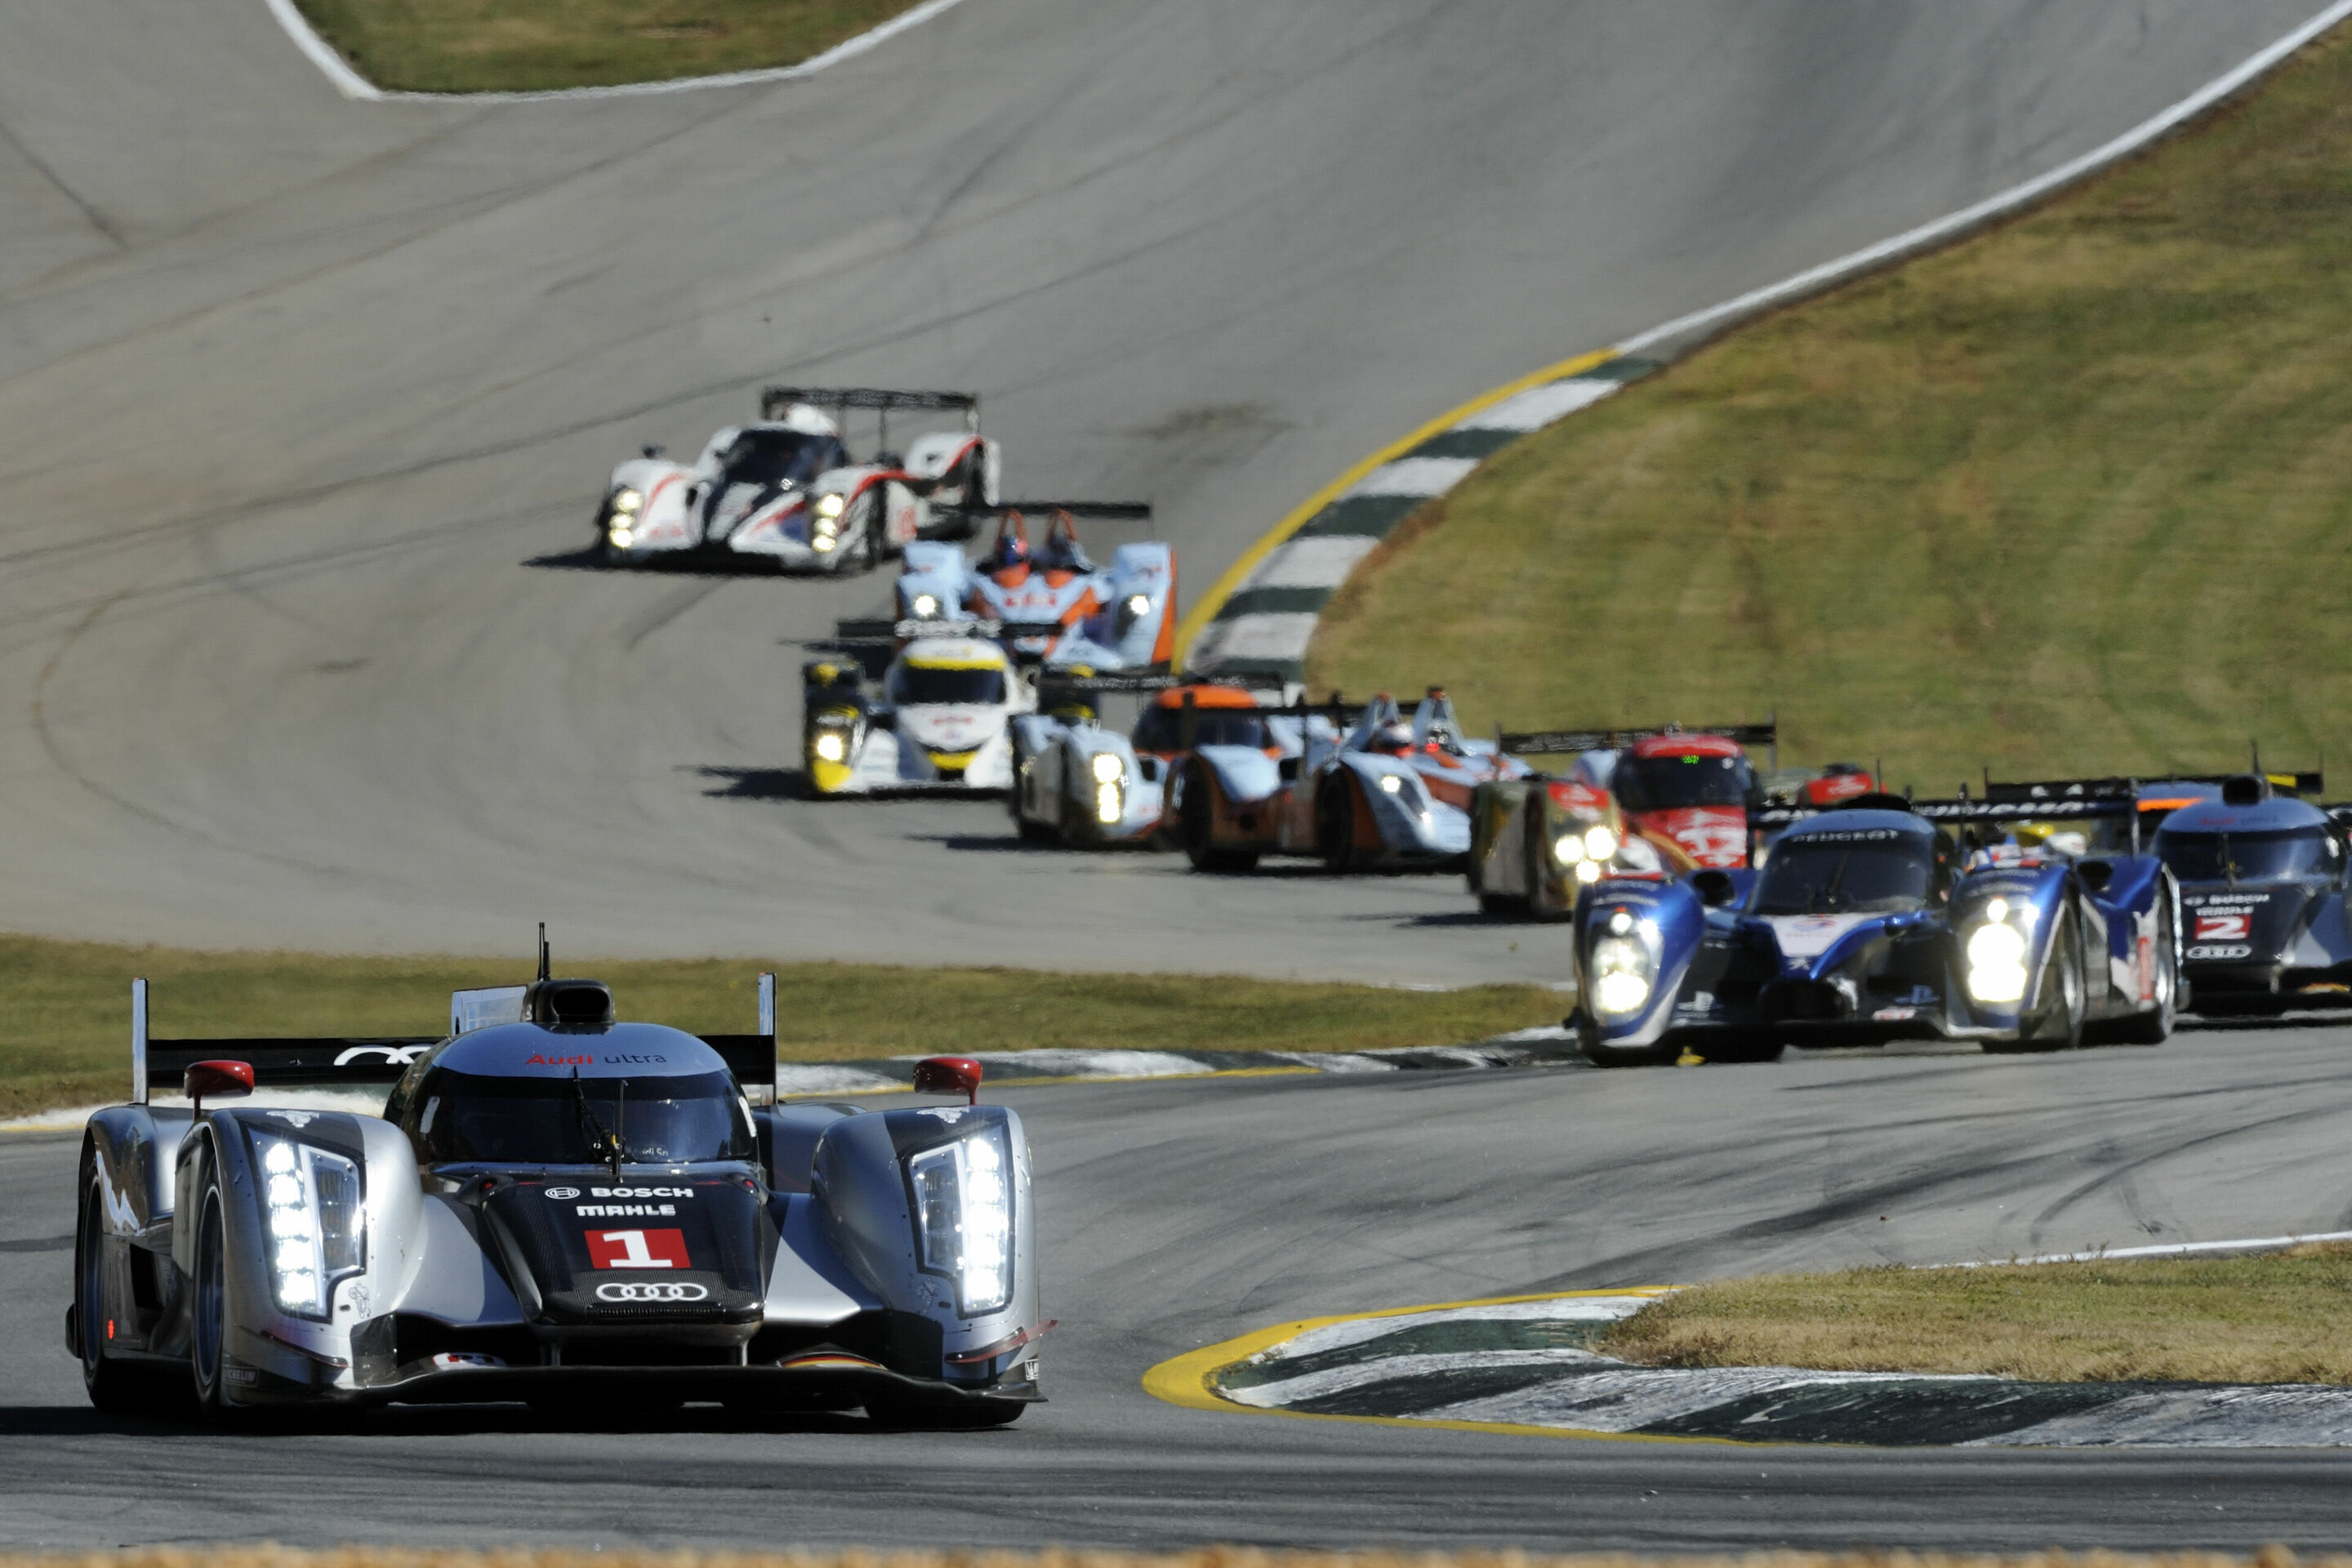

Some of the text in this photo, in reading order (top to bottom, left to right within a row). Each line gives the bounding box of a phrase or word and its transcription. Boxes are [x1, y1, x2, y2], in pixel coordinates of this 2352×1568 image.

[2197, 915, 2247, 940] 2
[526, 1054, 666, 1065] Audi ultra
[590, 1187, 694, 1198] BOSCH
[576, 1205, 676, 1217] MAHLE
[603, 1230, 673, 1267] 1
